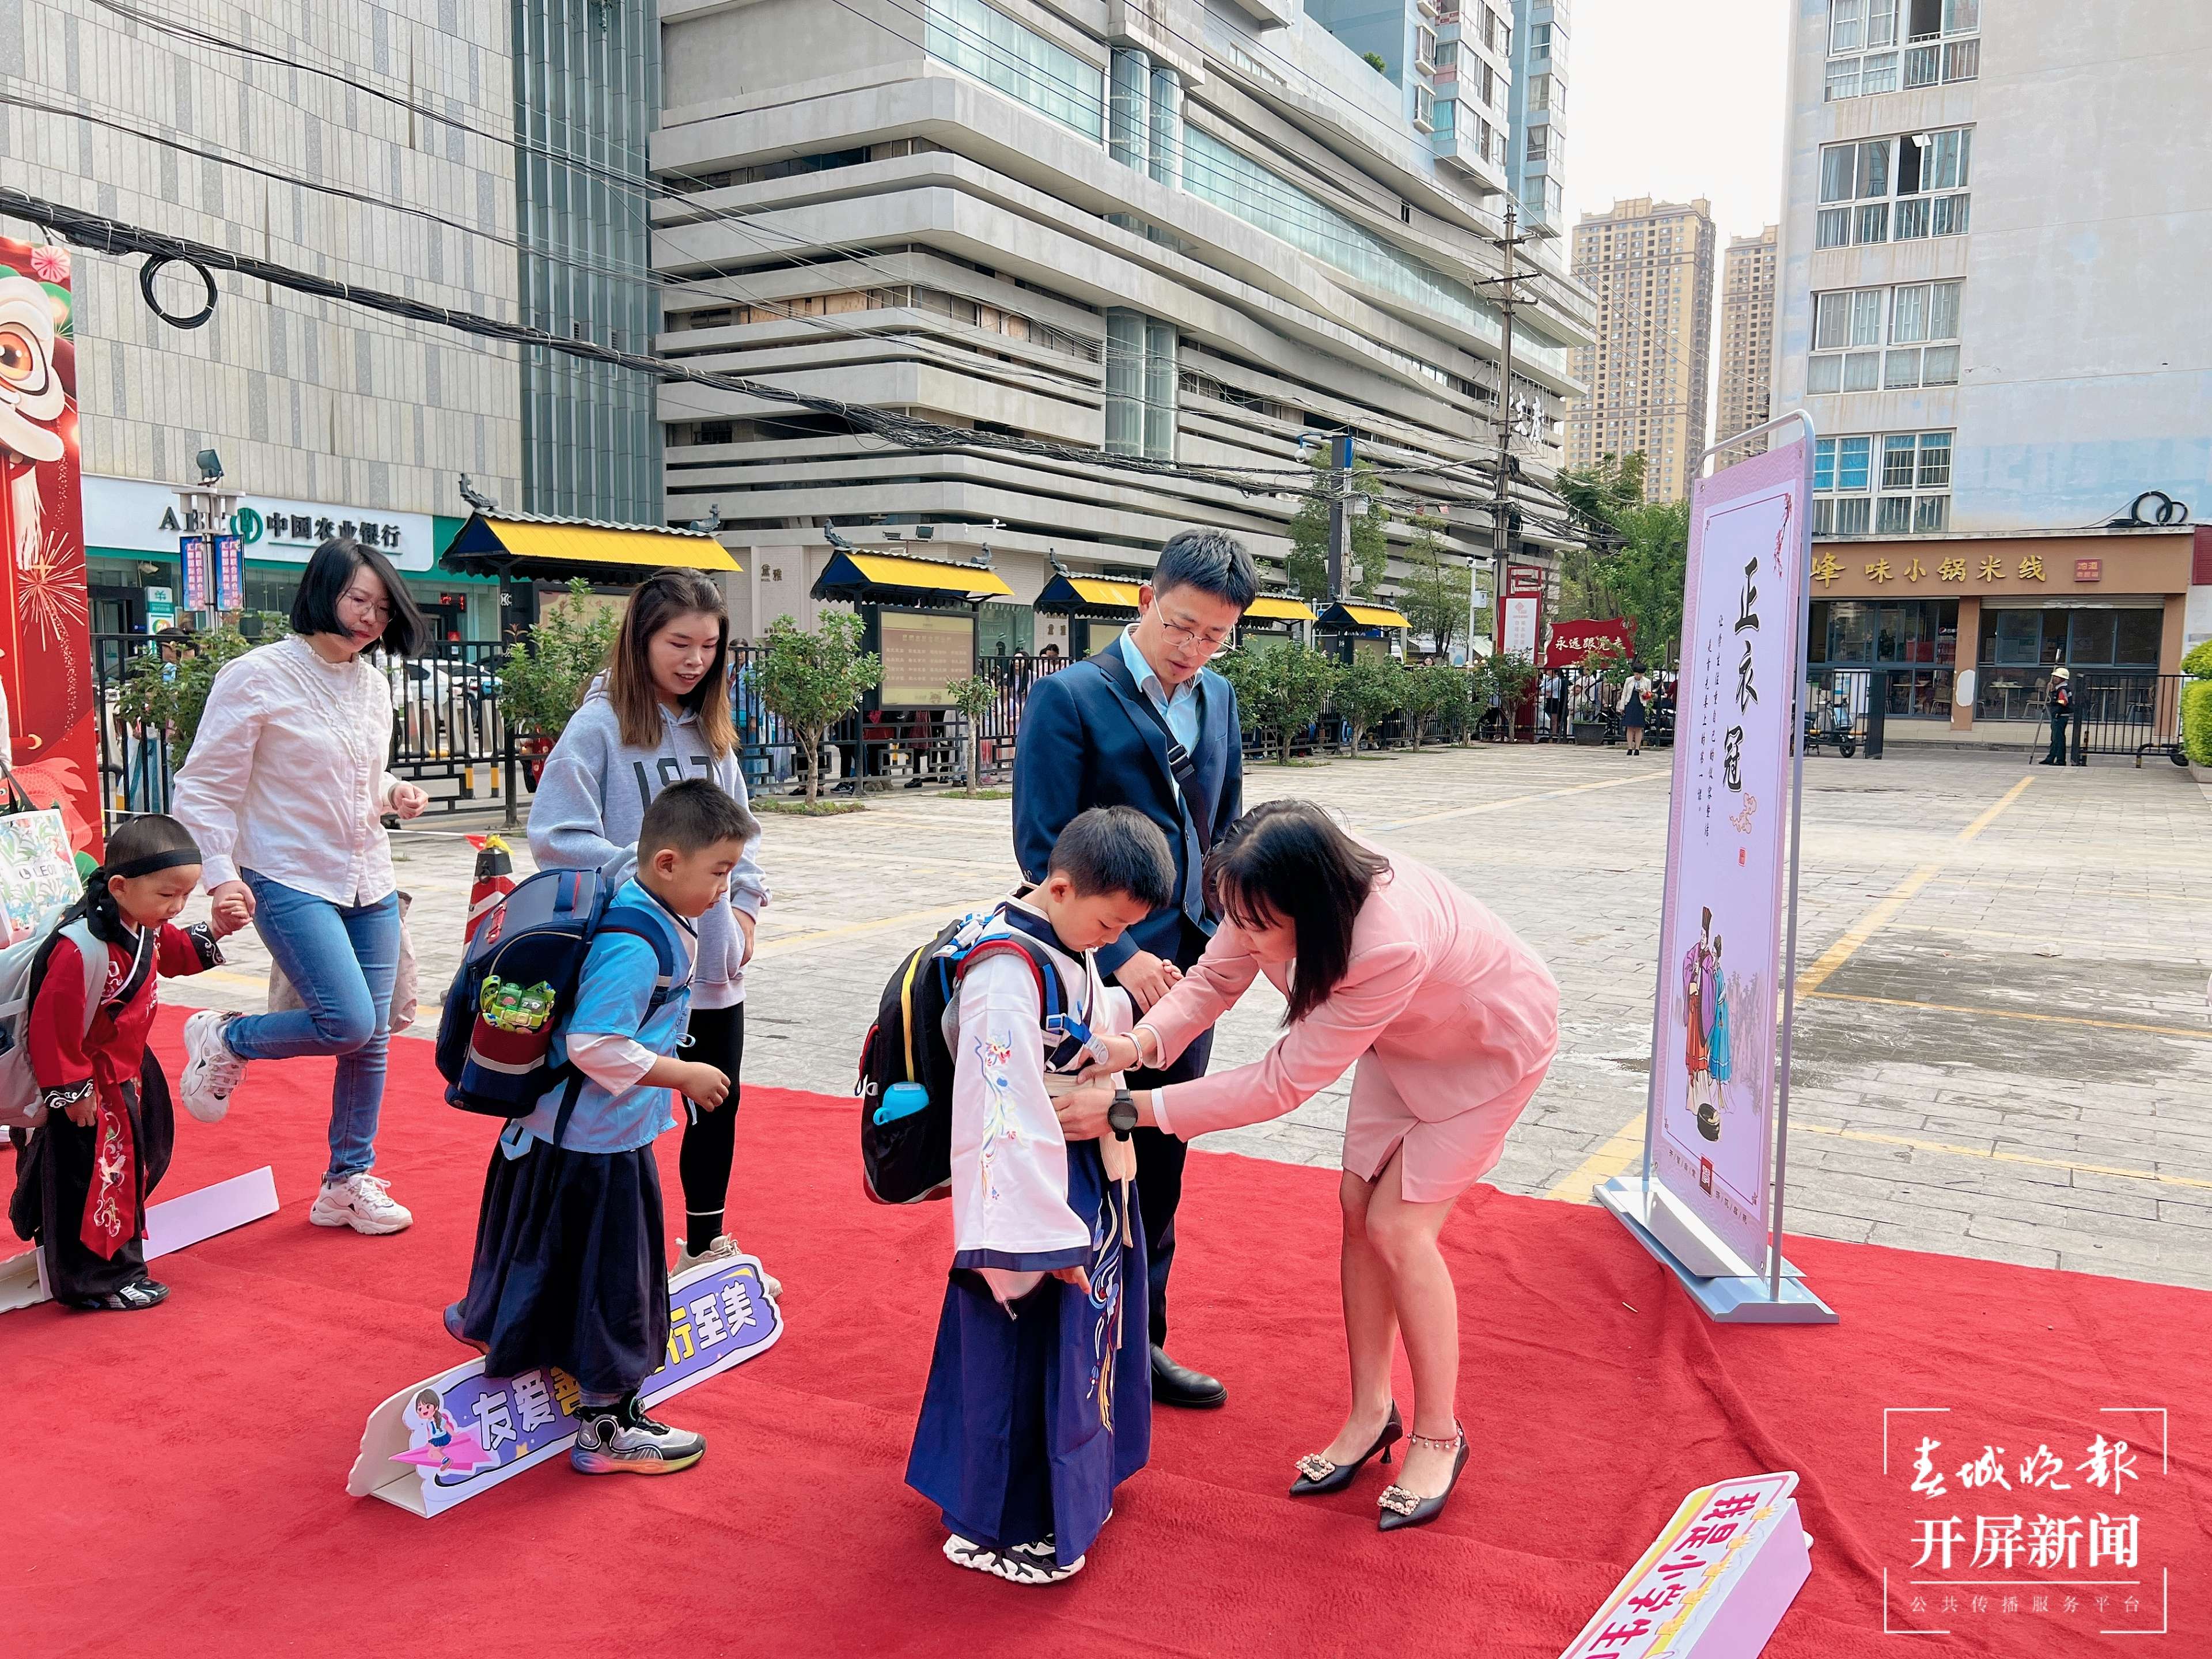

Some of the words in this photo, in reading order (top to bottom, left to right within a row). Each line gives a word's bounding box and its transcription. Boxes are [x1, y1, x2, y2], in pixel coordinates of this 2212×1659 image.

[266, 512, 402, 548] 中国农业银行
[1723, 556, 1759, 792] 正衣冠
